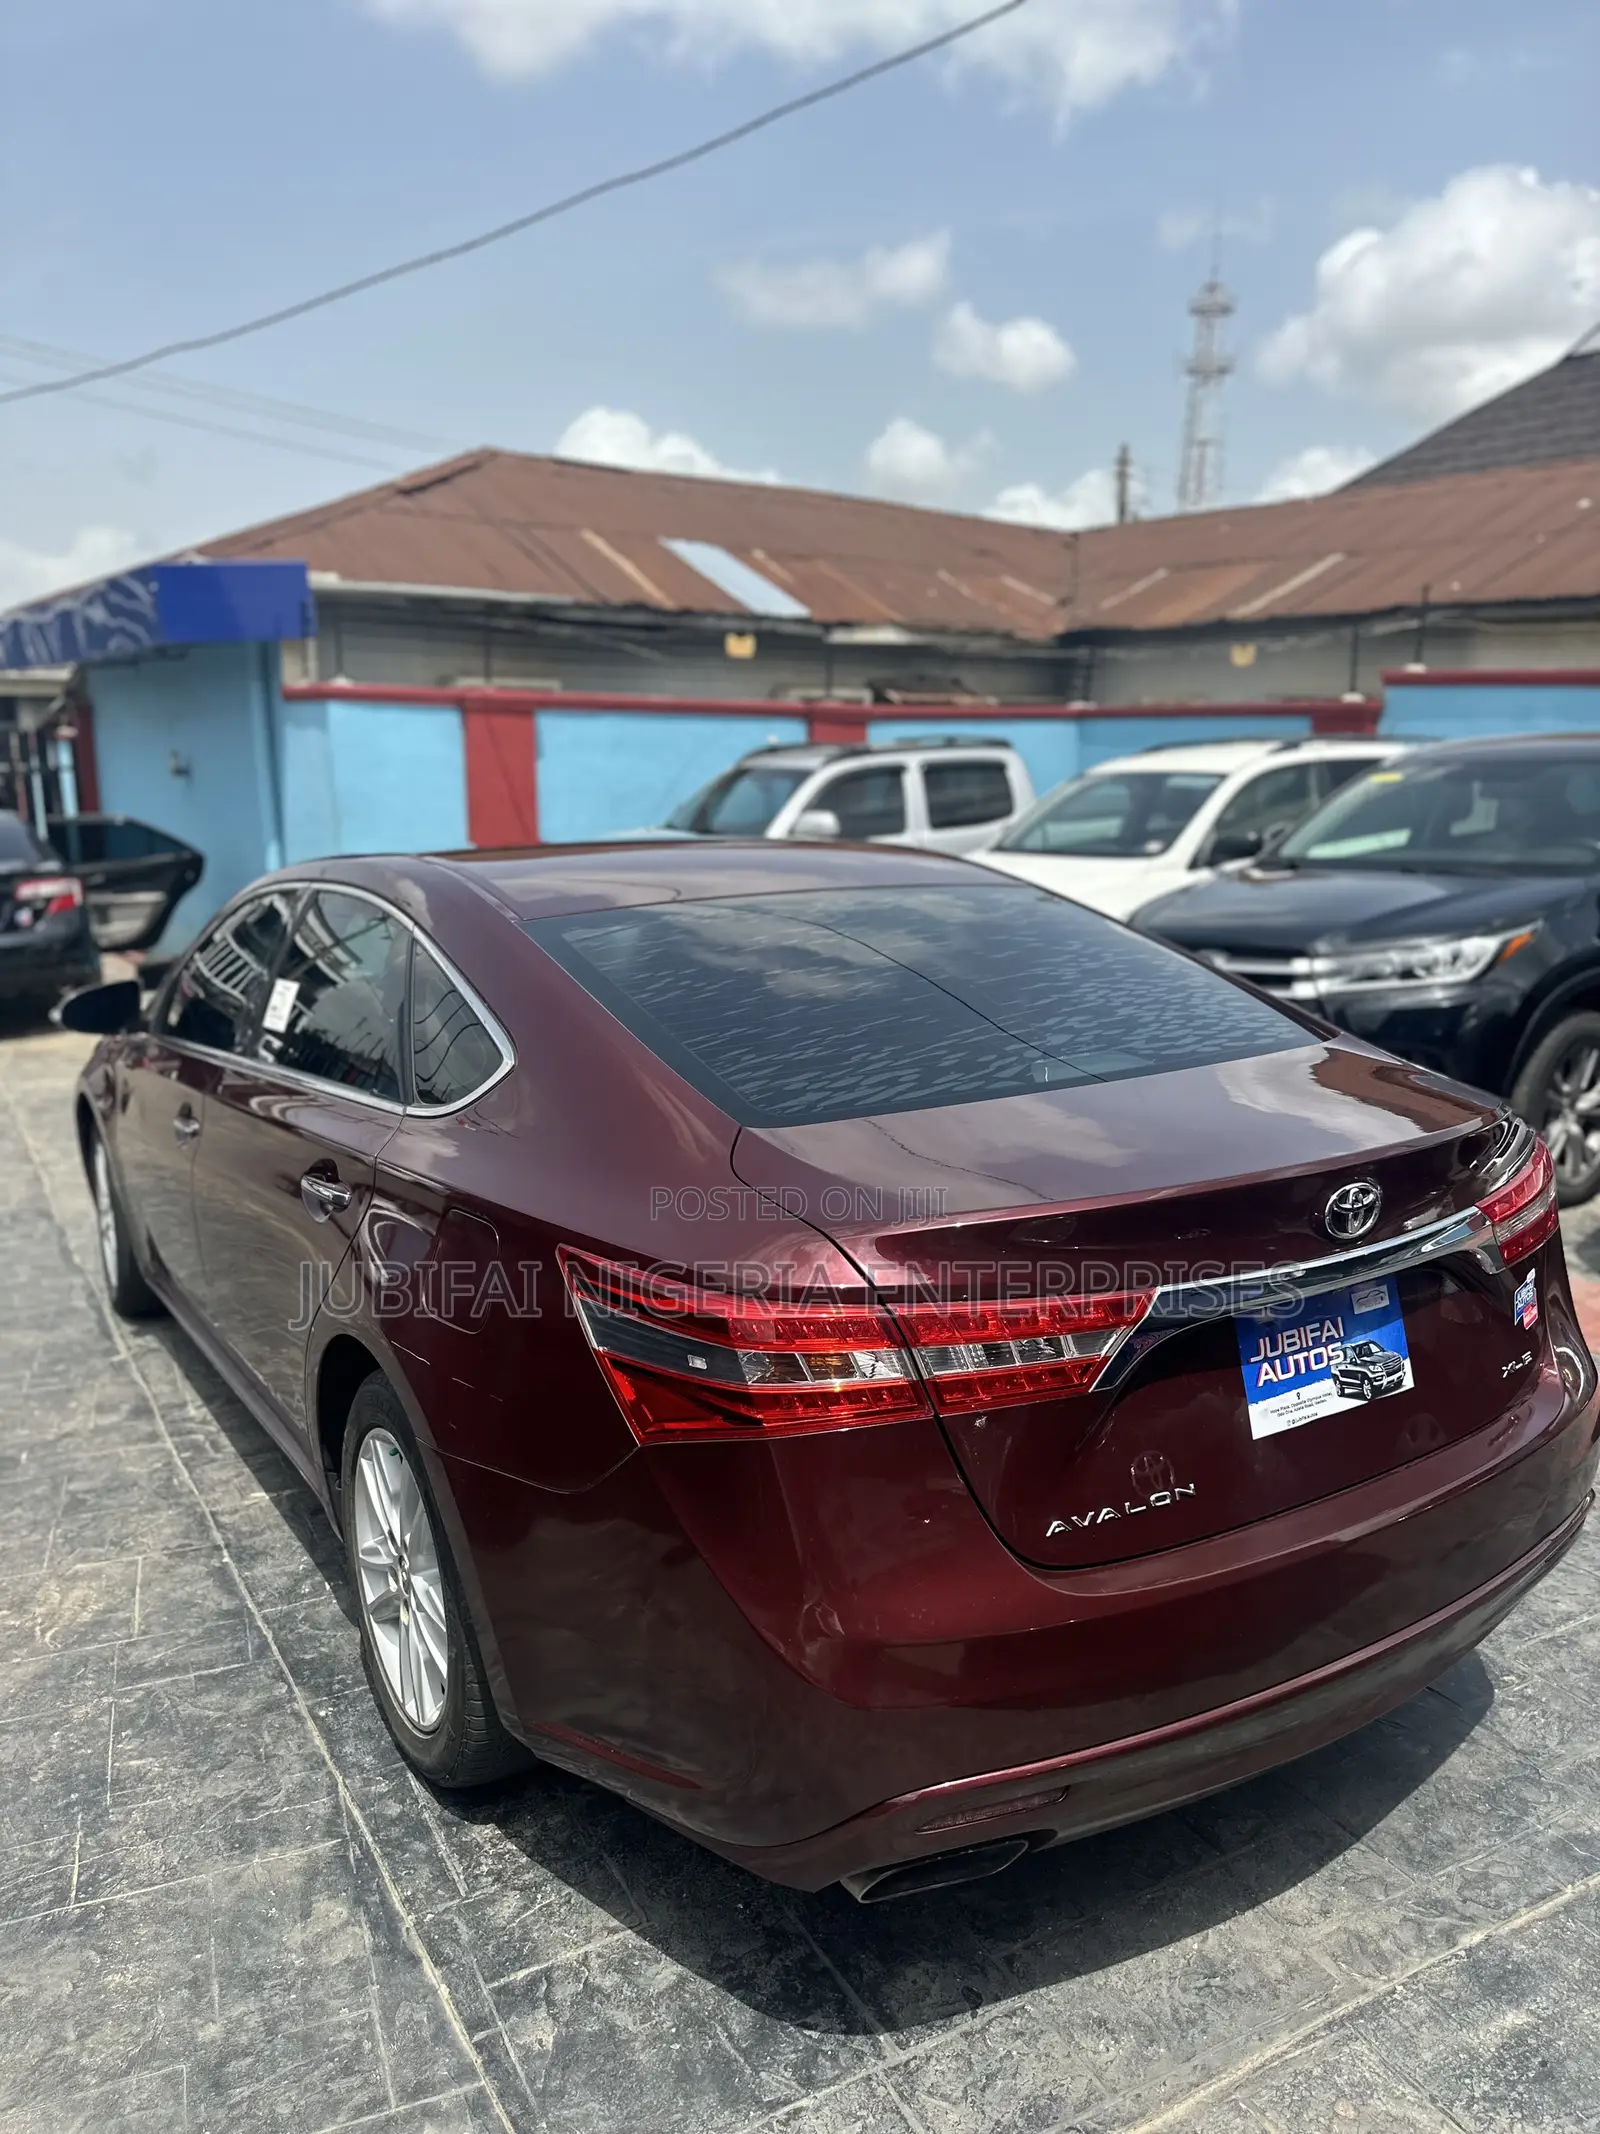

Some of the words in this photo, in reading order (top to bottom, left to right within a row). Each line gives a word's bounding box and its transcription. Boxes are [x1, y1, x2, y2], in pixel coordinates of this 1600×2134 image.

[1249, 1316, 1345, 1363] JUBIFAI
[1257, 1341, 1345, 1387] AUTOS
[1501, 1351, 1533, 1378] XLE
[1045, 1483, 1196, 1537] AVALON
